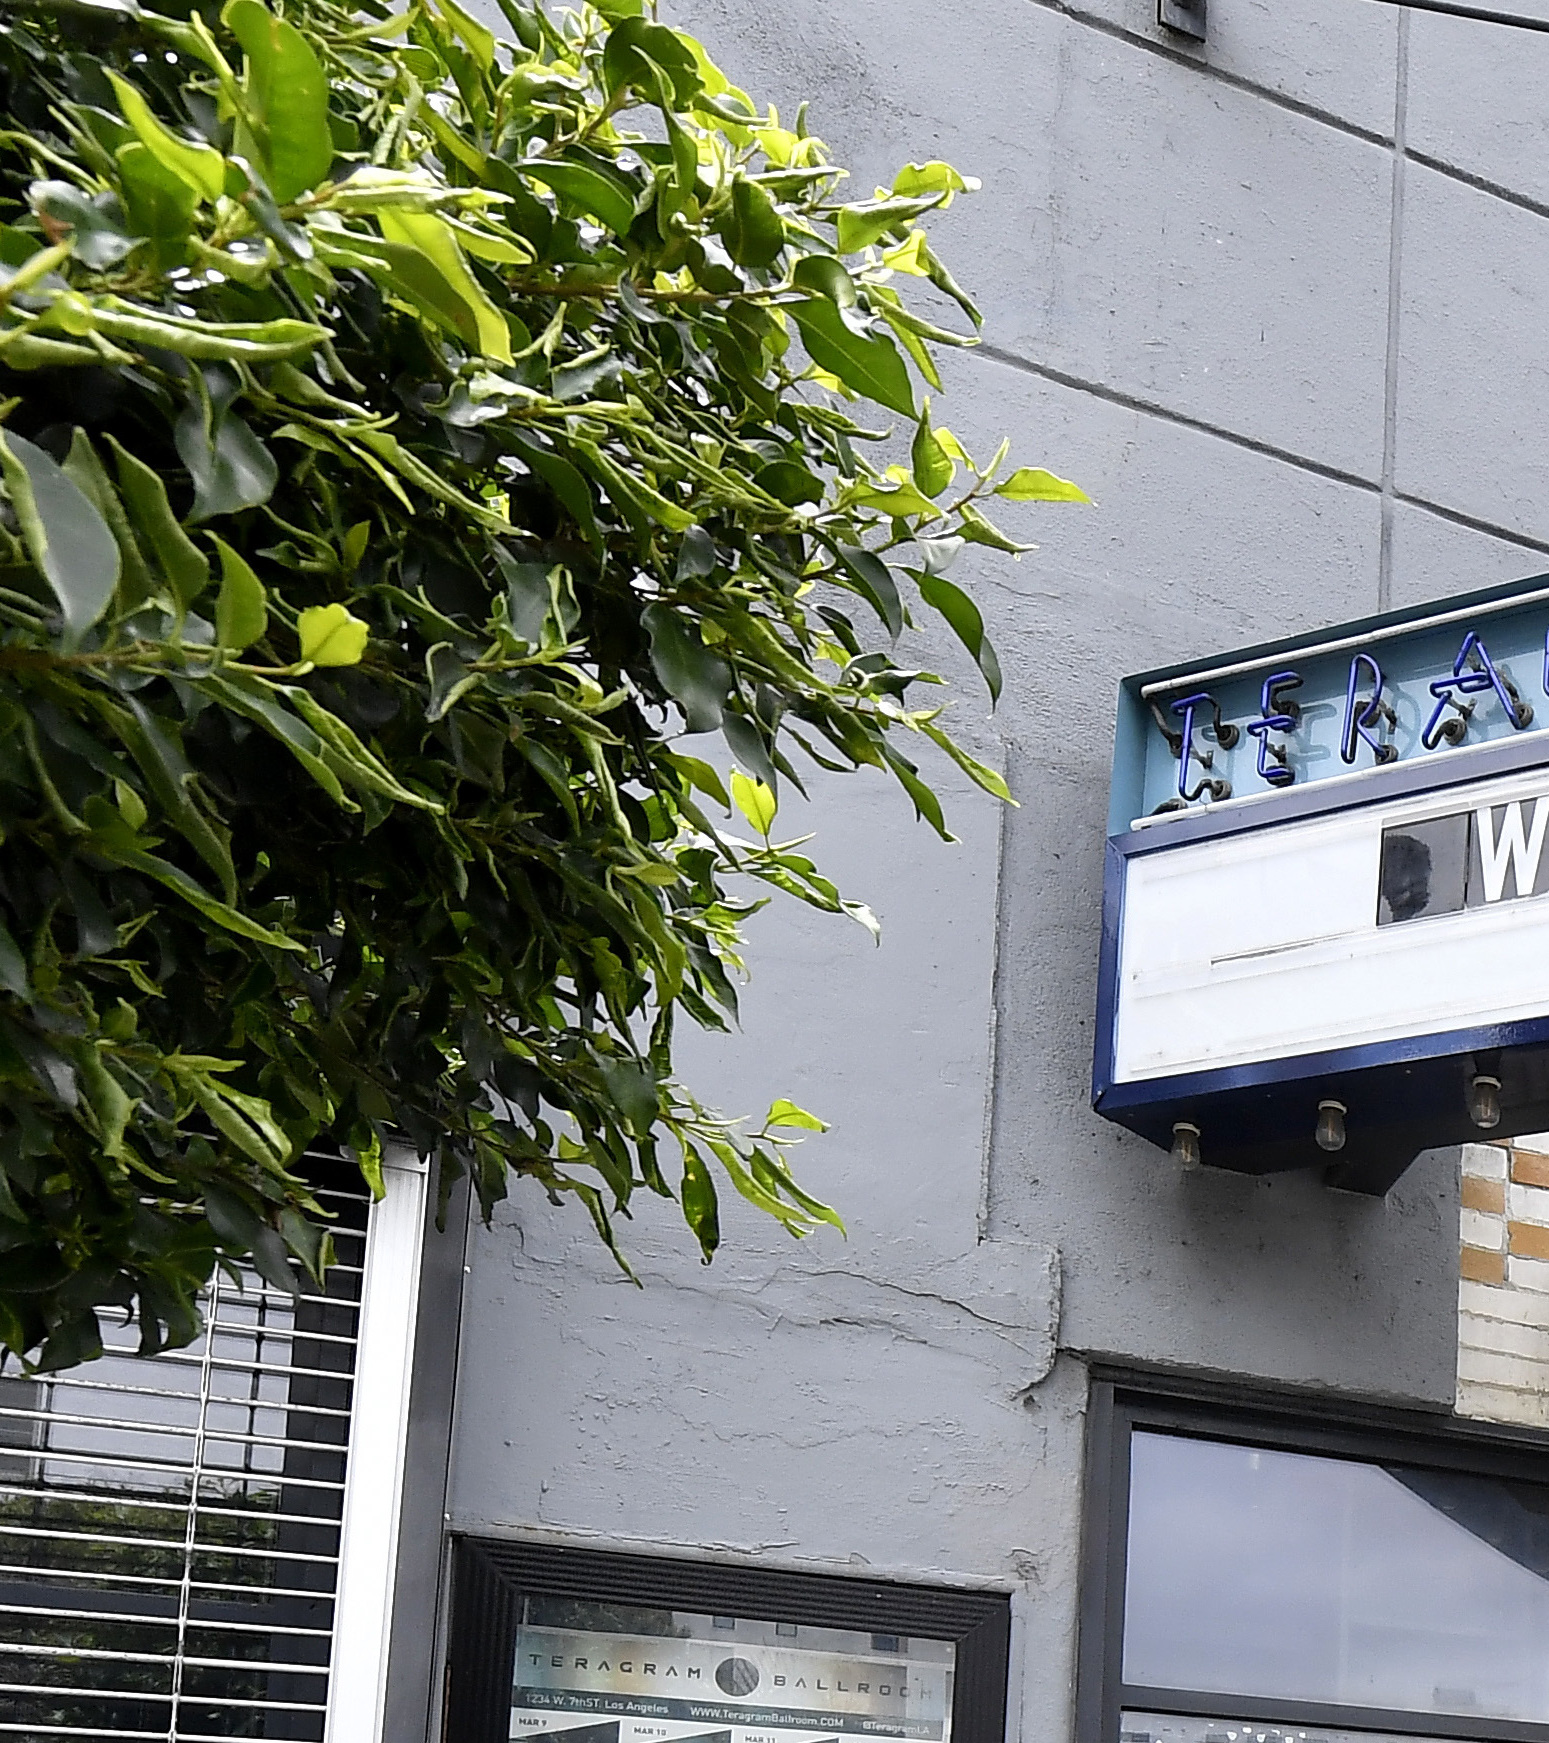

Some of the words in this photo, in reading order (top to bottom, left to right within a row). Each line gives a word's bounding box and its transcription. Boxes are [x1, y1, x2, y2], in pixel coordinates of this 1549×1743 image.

[528, 1654, 702, 1680] TERAGRAM
[526, 1693, 550, 1705] 1234
[604, 1700, 624, 1711] Los
[626, 1701, 669, 1715] Angeles
[519, 1717, 540, 1727] MAR
[541, 1719, 548, 1728] 9
[633, 1726, 655, 1736] MAR
[744, 1735, 766, 1743] MAR
